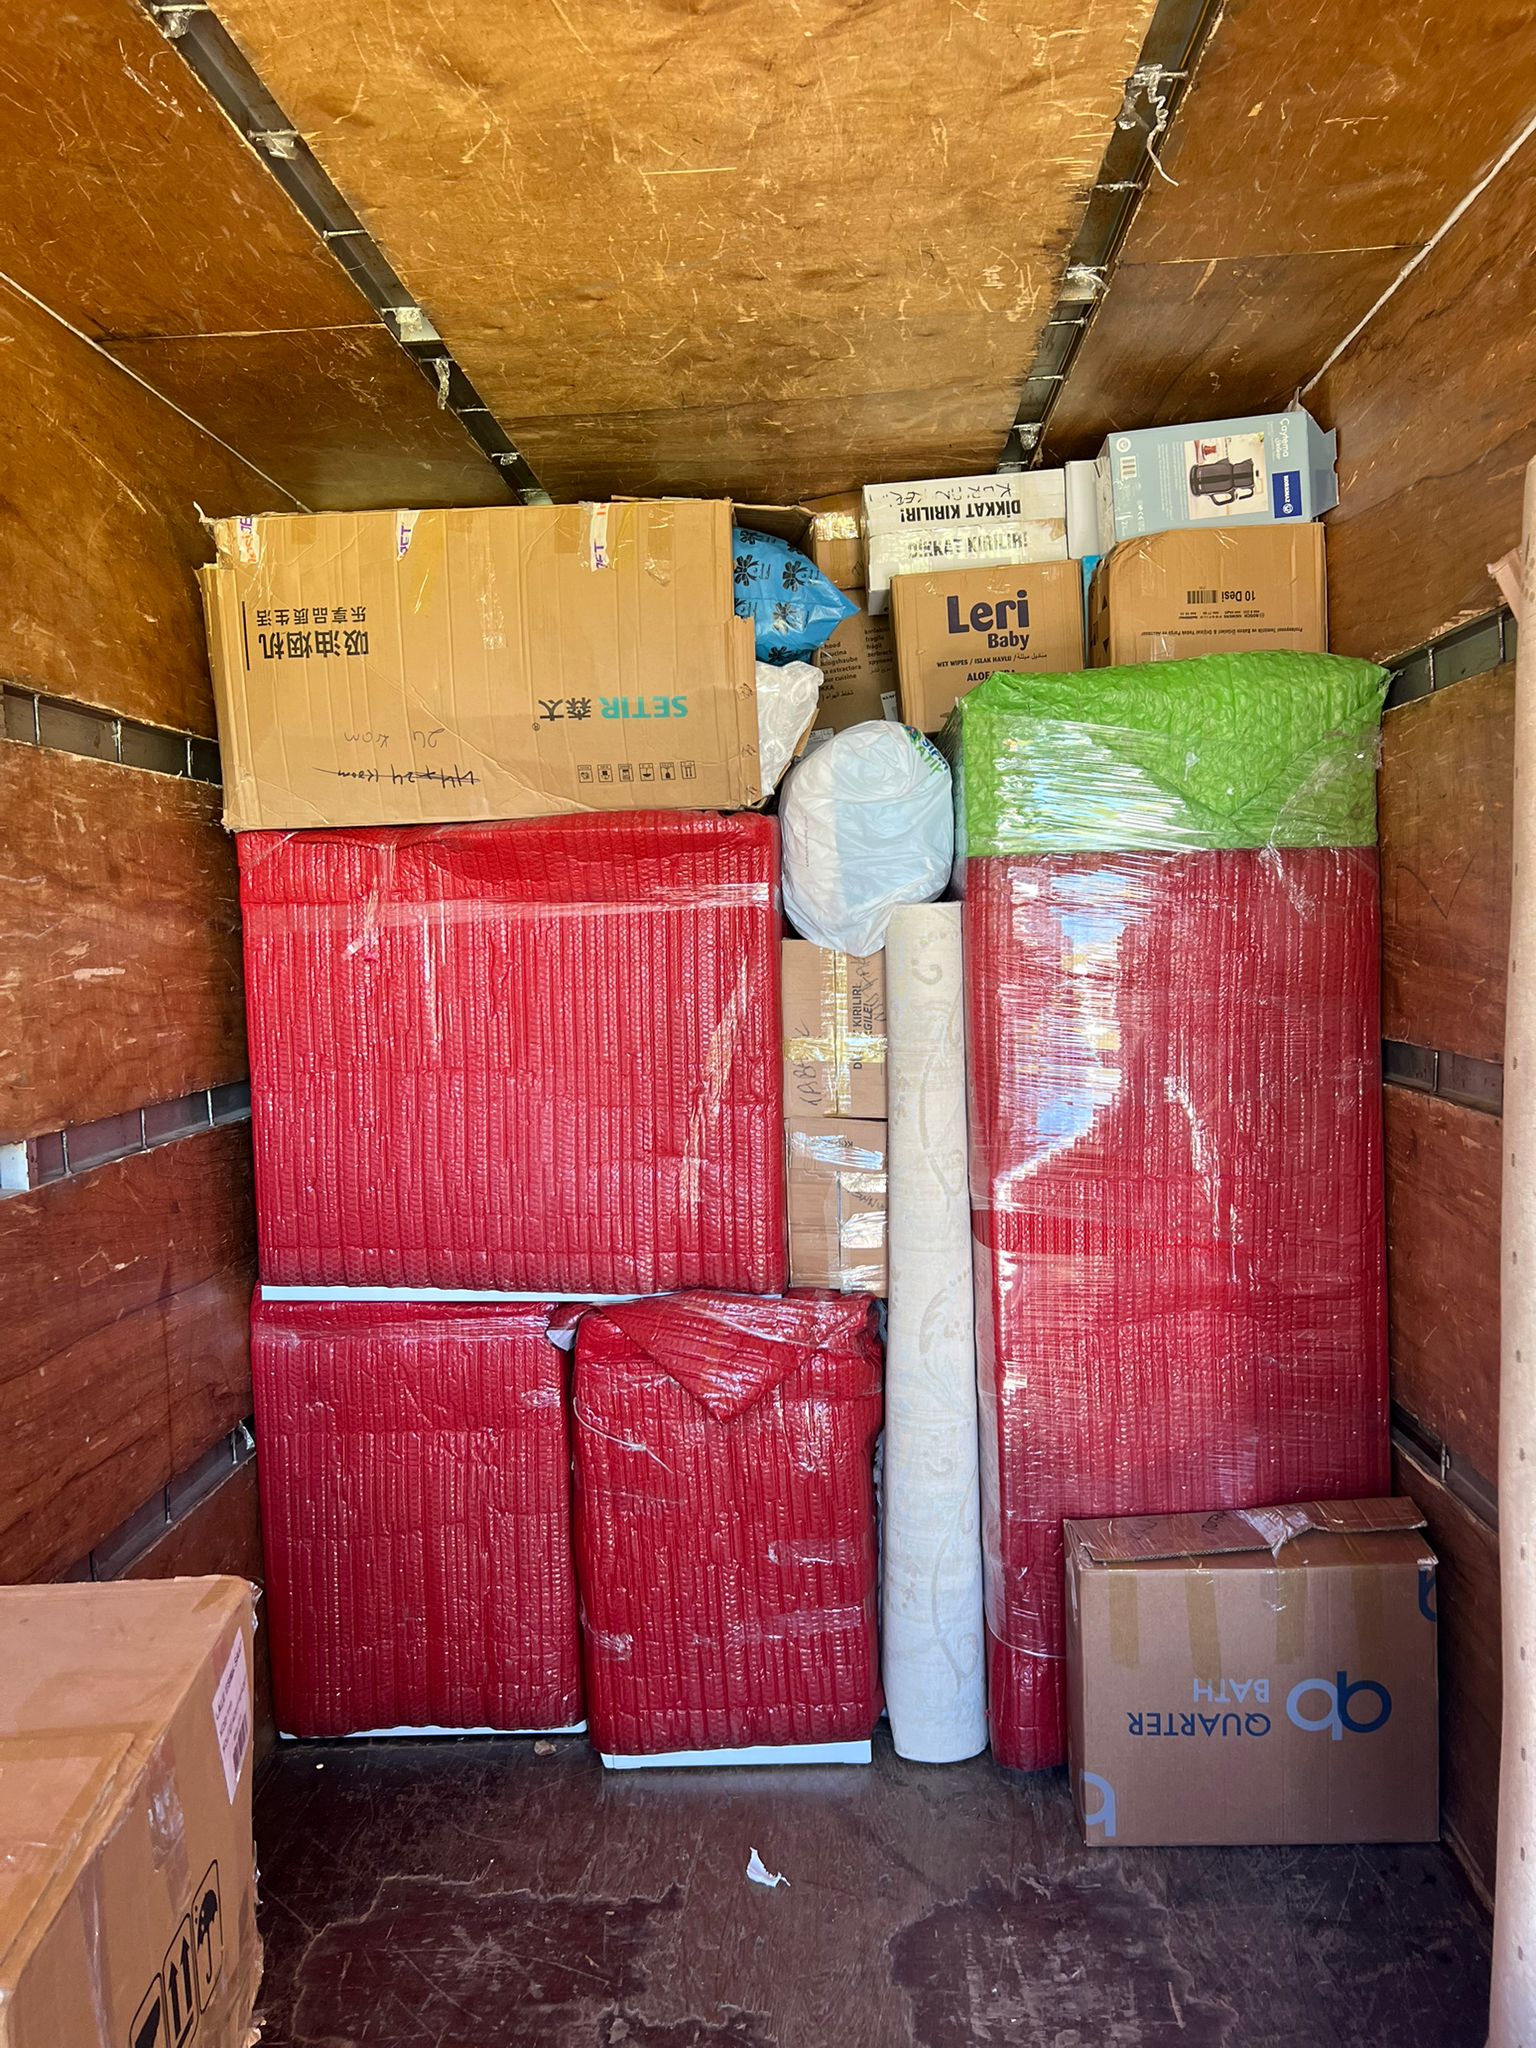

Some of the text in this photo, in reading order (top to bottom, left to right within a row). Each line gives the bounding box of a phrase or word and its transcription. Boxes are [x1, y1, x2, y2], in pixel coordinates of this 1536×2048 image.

[901, 499, 1021, 523] DİKKAT KIRILIR!
[1221, 590, 1256, 603] 10 Desi
[256, 606, 366, 627] 乐享品质生活
[947, 589, 1030, 634] Leri
[259, 630, 369, 660] 吸油烟机
[988, 630, 1030, 651] Baby
[936, 660, 948, 668] WET
[950, 659, 968, 667] WIPES
[992, 655, 1012, 663] HAVLU
[538, 697, 592, 721] 森太
[599, 696, 688, 720] SETIR
[1192, 1678, 1270, 1704] BATH
[1126, 1711, 1272, 1737] QUARTER
